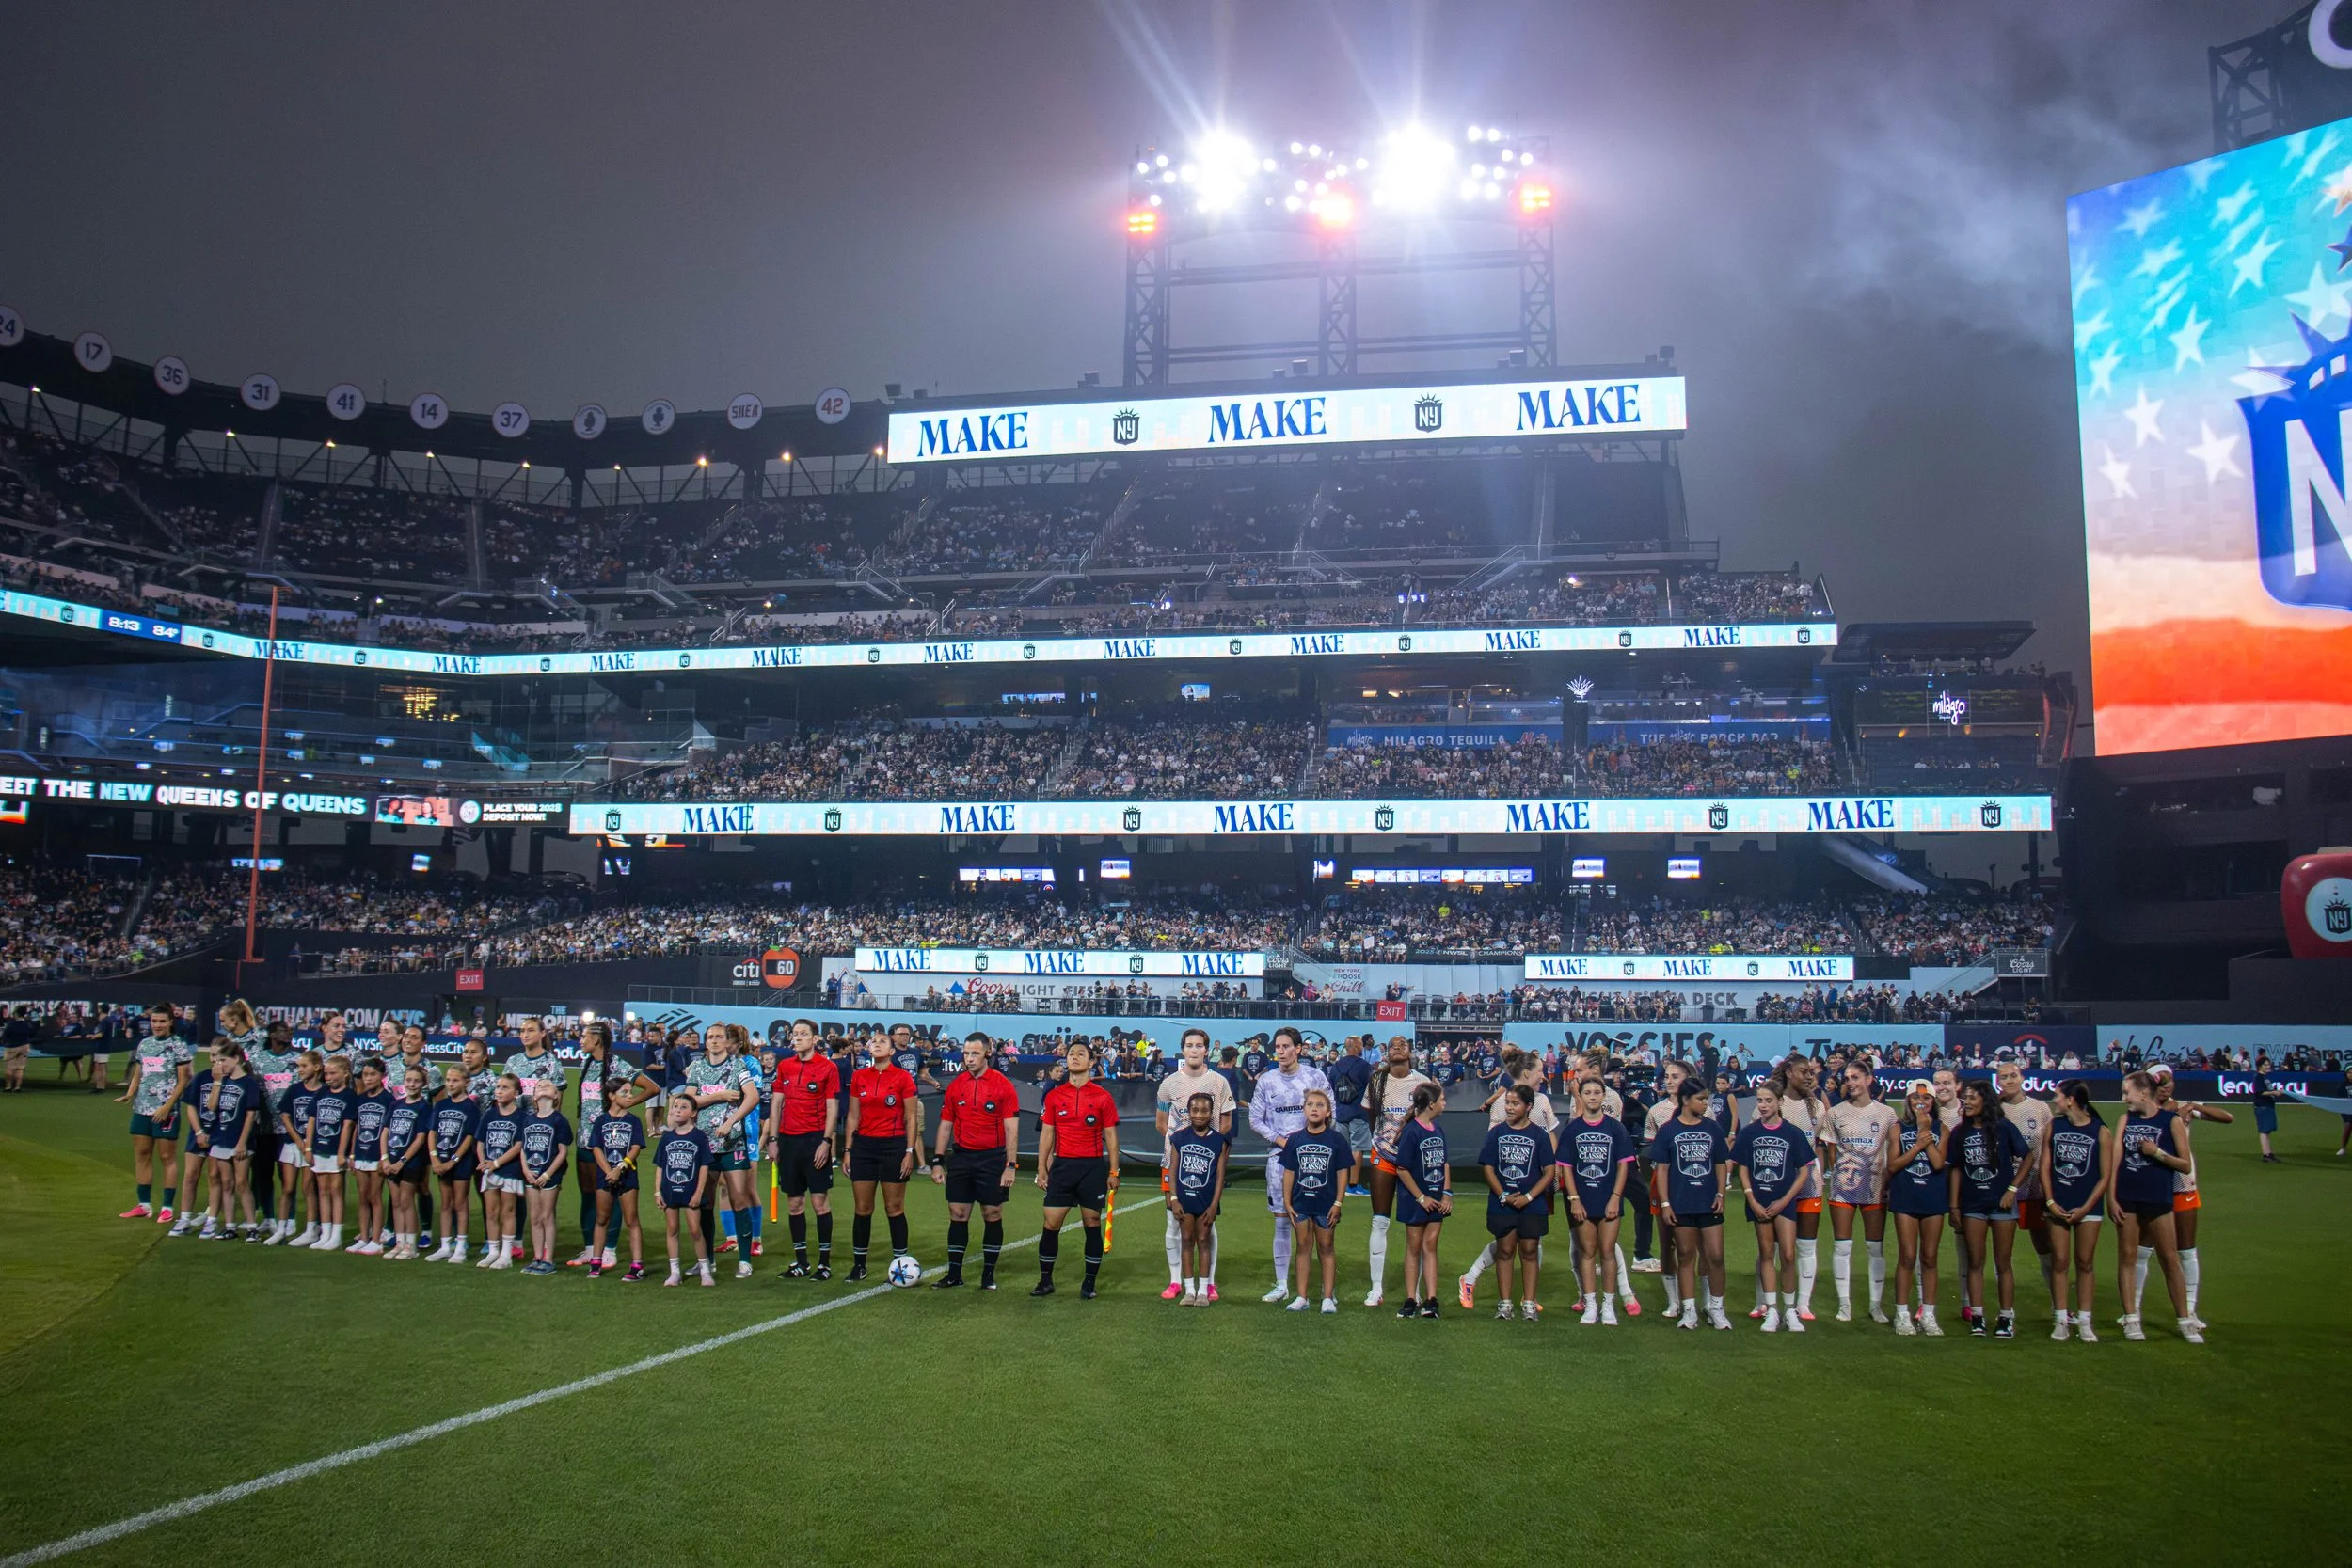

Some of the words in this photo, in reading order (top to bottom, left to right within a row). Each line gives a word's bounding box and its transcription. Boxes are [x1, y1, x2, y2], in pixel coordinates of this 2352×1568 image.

[85, 342, 102, 361] 17
[162, 366, 183, 386] 36
[251, 384, 270, 402] 31
[336, 393, 355, 411] 41
[421, 403, 438, 420] 14
[821, 397, 844, 415] 42
[1516, 384, 1641, 431] MAKE
[501, 411, 522, 428] 37
[1207, 397, 1327, 443] MAKE
[917, 411, 1028, 457] MAKE
[108, 616, 140, 632] 8:13
[1290, 634, 1344, 655] MAKE
[1485, 629, 1541, 651] MAKE
[1683, 626, 1740, 647] MAKE
[252, 641, 305, 660] MAKE
[752, 647, 802, 668] MAKE
[924, 642, 974, 664] MAKE
[1104, 639, 1156, 659] MAKE
[432, 656, 482, 673] MAKE
[590, 653, 635, 672] MAKE
[1932, 690, 1965, 725] milagro
[1449, 735, 1506, 746] TEQUILA
[43, 779, 95, 800] THE
[99, 782, 154, 802] NEW
[157, 785, 241, 809] QUEENS
[244, 791, 279, 810] OF
[282, 793, 367, 815] QUEENS
[483, 803, 513, 813] PLACE
[514, 803, 538, 813] YOUR
[1213, 802, 1295, 832] MAKE
[1505, 801, 1590, 832] MAKE
[1807, 800, 1895, 831] MAKE
[482, 813, 520, 822] DEPOSIT
[521, 813, 547, 822] NOW!
[682, 806, 754, 832] MAKE
[939, 804, 1016, 832] MAKE
[777, 960, 794, 975] 60
[873, 949, 931, 971] MAKE
[1024, 952, 1085, 974] MAKE
[1181, 953, 1245, 975] MAKE
[1539, 958, 1588, 976] MAKE
[1663, 958, 1712, 976] MAKE
[1788, 959, 1837, 977] MAKE
[2010, 958, 2034, 969] Coors
[733, 961, 759, 978] citi
[460, 974, 479, 985] EXIT
[967, 976, 1011, 995] Coors
[1014, 984, 1056, 996] LIGHT
[1331, 980, 1365, 993] Chill
[1692, 992, 1738, 1006] DECK
[550, 1006, 567, 1015] THE
[1379, 1006, 1402, 1017] EXIT
[669, 1152, 692, 1161] QUEENS
[1501, 1146, 1530, 1155] QUEENS
[1501, 1152, 1529, 1162] CLASSIC
[1579, 1151, 1607, 1160] CLASSIC
[1680, 1144, 1709, 1152] QUEENS
[1756, 1148, 1784, 1158] QUEENS
[2057, 1144, 2088, 1153] QUEENS
[2057, 1150, 2087, 1161] CLASSIC
[668, 1159, 692, 1167] CLASSIC
[1183, 1162, 1208, 1173] CLASSIC
[1184, 1155, 1208, 1166] QUEENS
[1300, 1163, 1326, 1171] CLASSIC
[1301, 1156, 1327, 1164] QUEENS
[1756, 1155, 1783, 1164] CLASSIC
